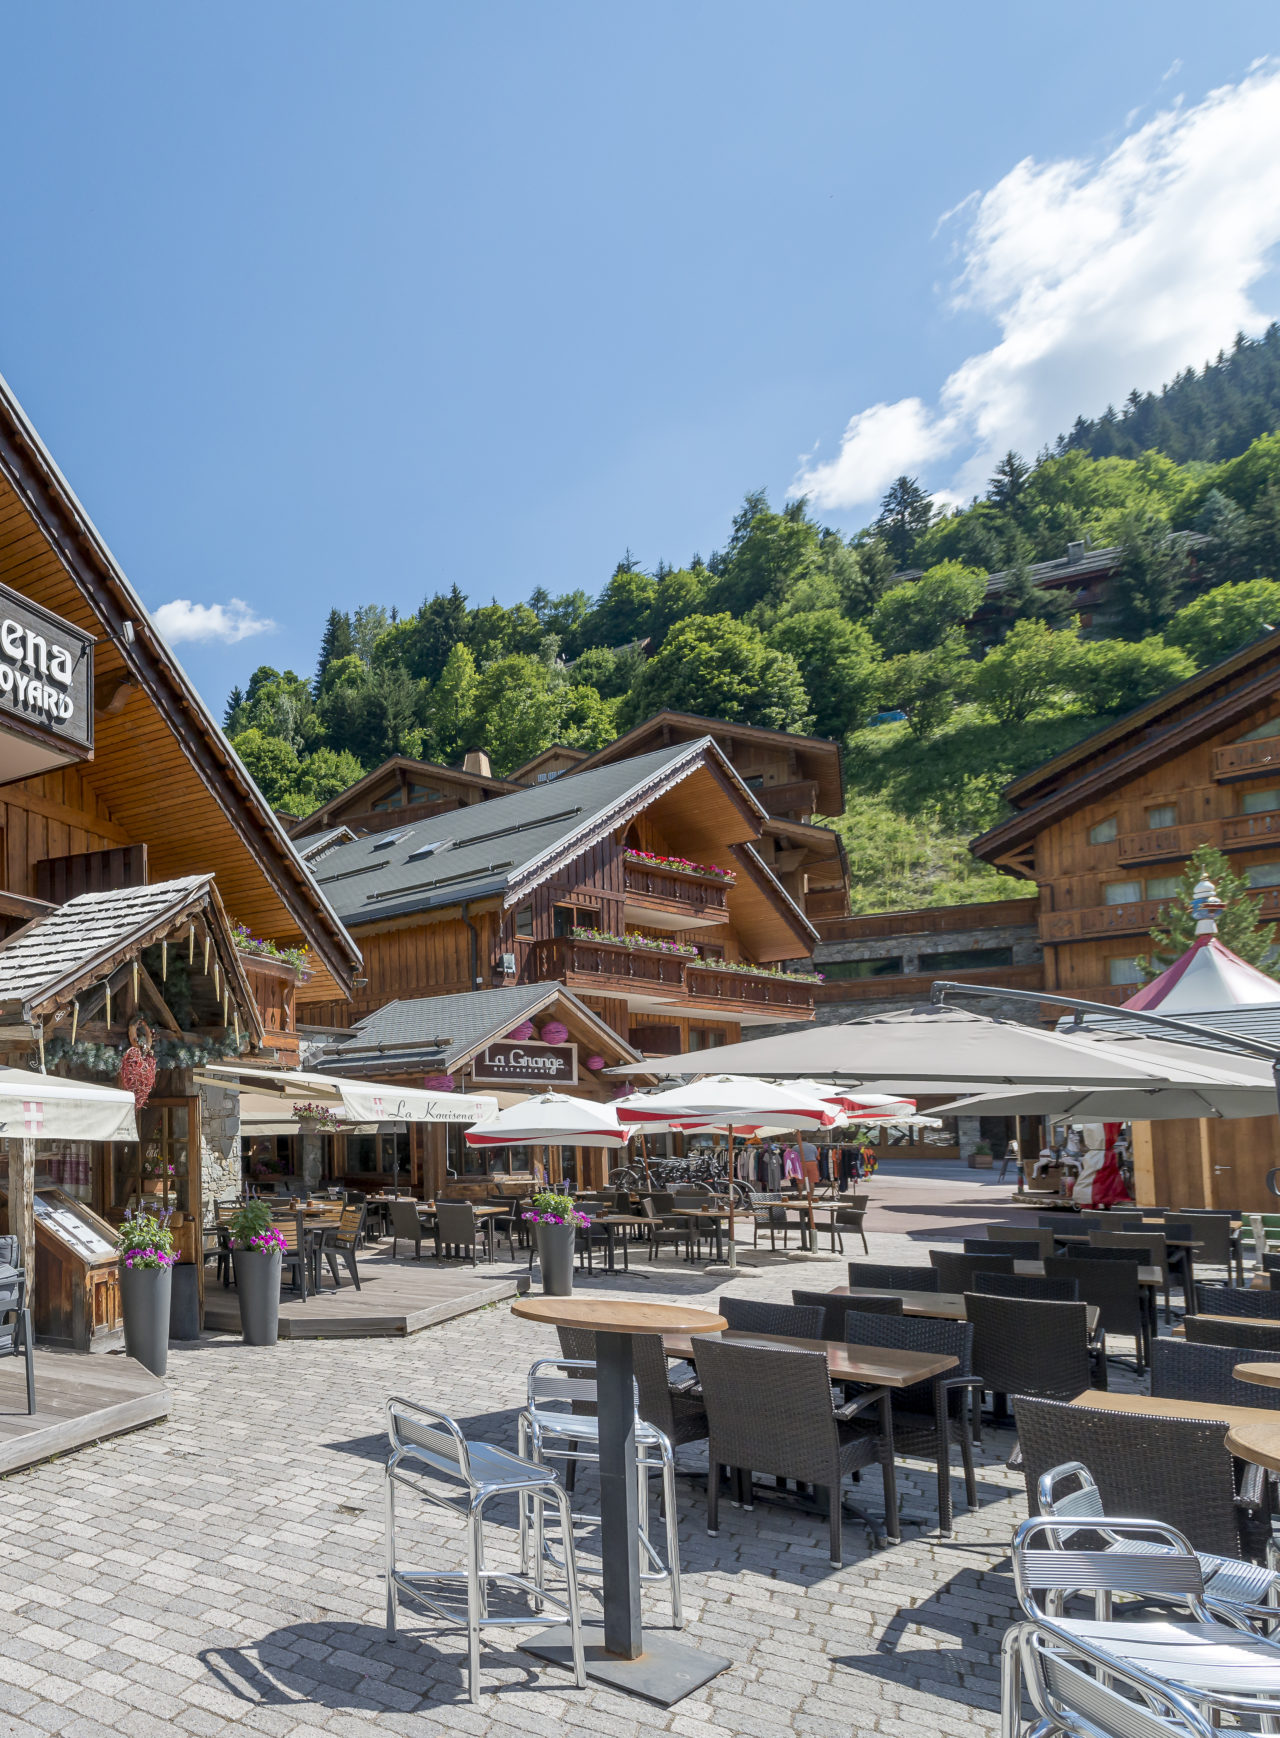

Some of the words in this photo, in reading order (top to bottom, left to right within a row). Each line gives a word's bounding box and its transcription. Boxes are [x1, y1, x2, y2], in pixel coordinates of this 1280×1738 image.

[484, 1047, 505, 1066] La
[509, 1049, 565, 1075] Grange
[388, 1099, 412, 1119] La
[417, 1101, 475, 1120] Kouisena
